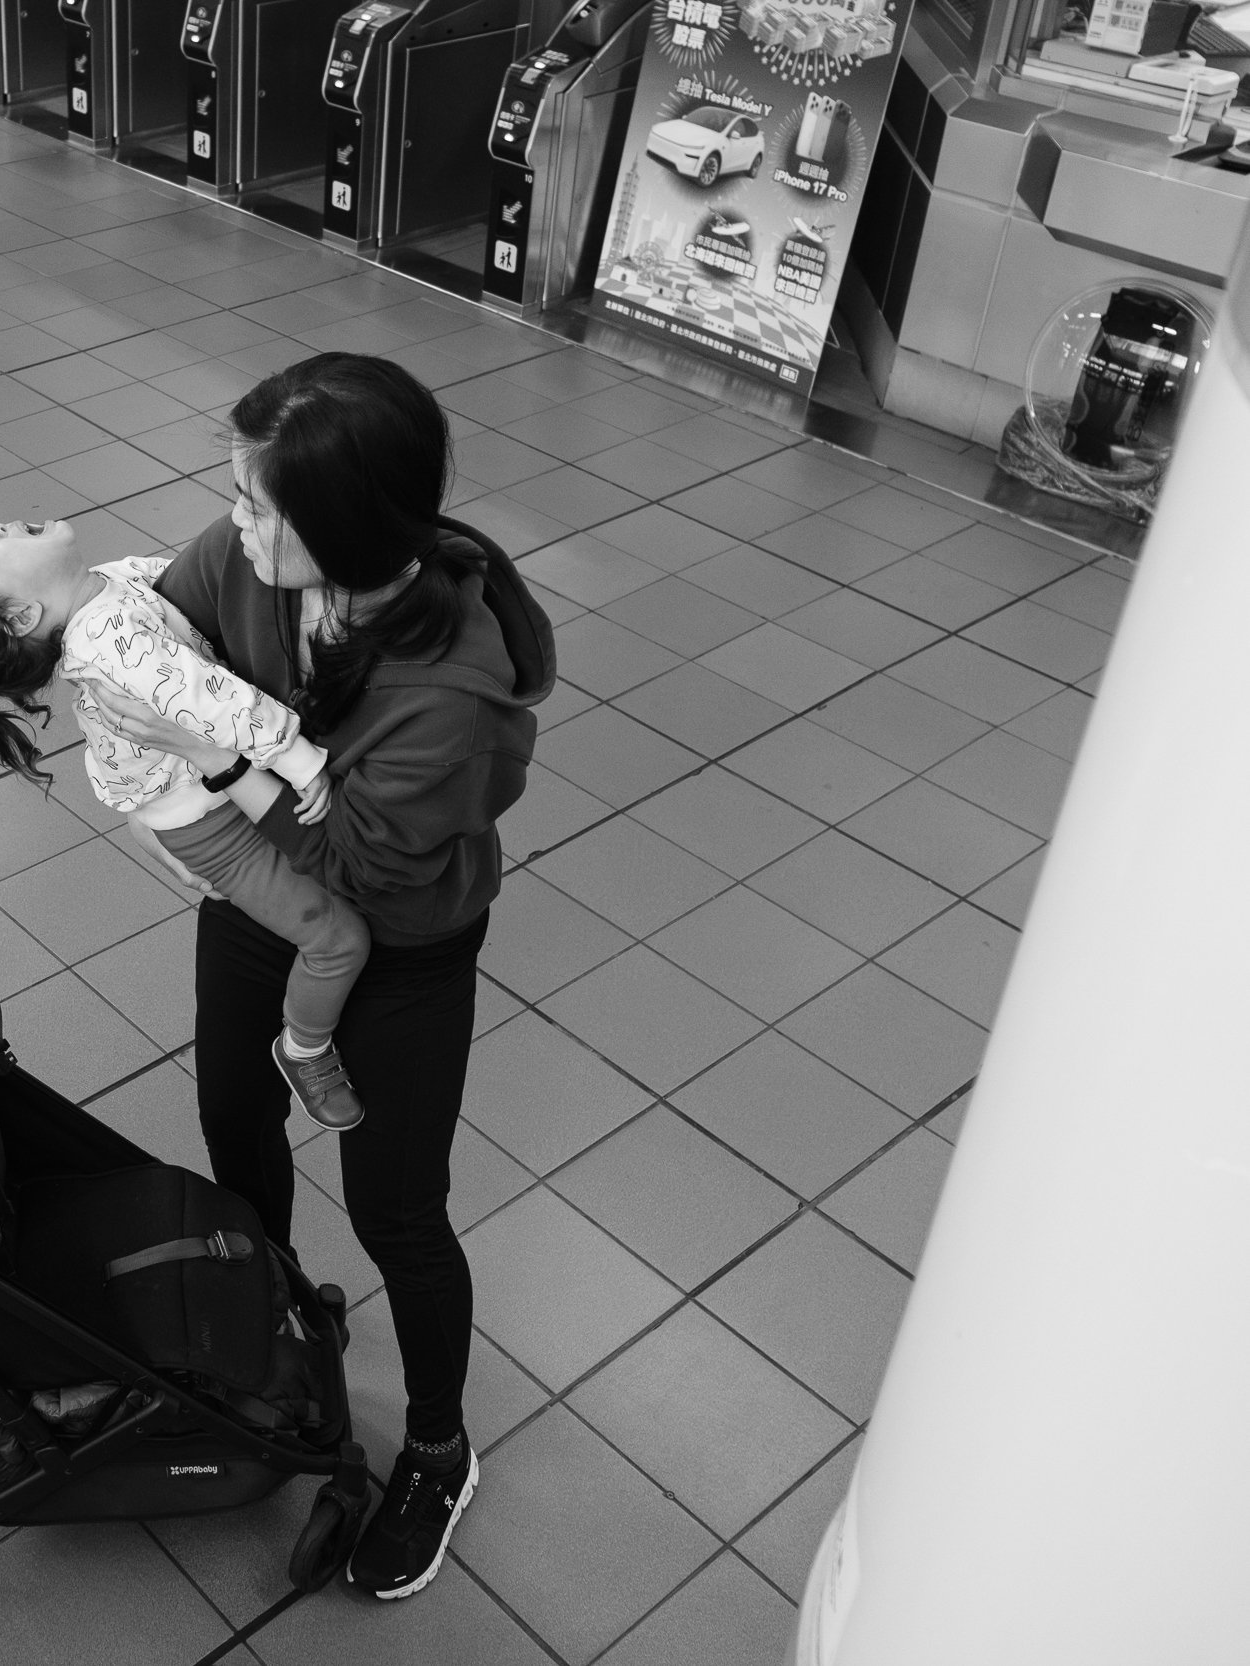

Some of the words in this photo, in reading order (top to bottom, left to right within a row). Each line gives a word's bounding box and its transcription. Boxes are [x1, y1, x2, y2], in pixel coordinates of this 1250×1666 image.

[672, 24, 707, 50] 股票
[704, 88, 732, 106] Tesla
[731, 96, 762, 114] Model
[760, 104, 773, 117] Y
[525, 174, 533, 184] 10
[773, 168, 812, 191] iPhone
[812, 180, 828, 195] 17
[827, 186, 847, 202] Pro
